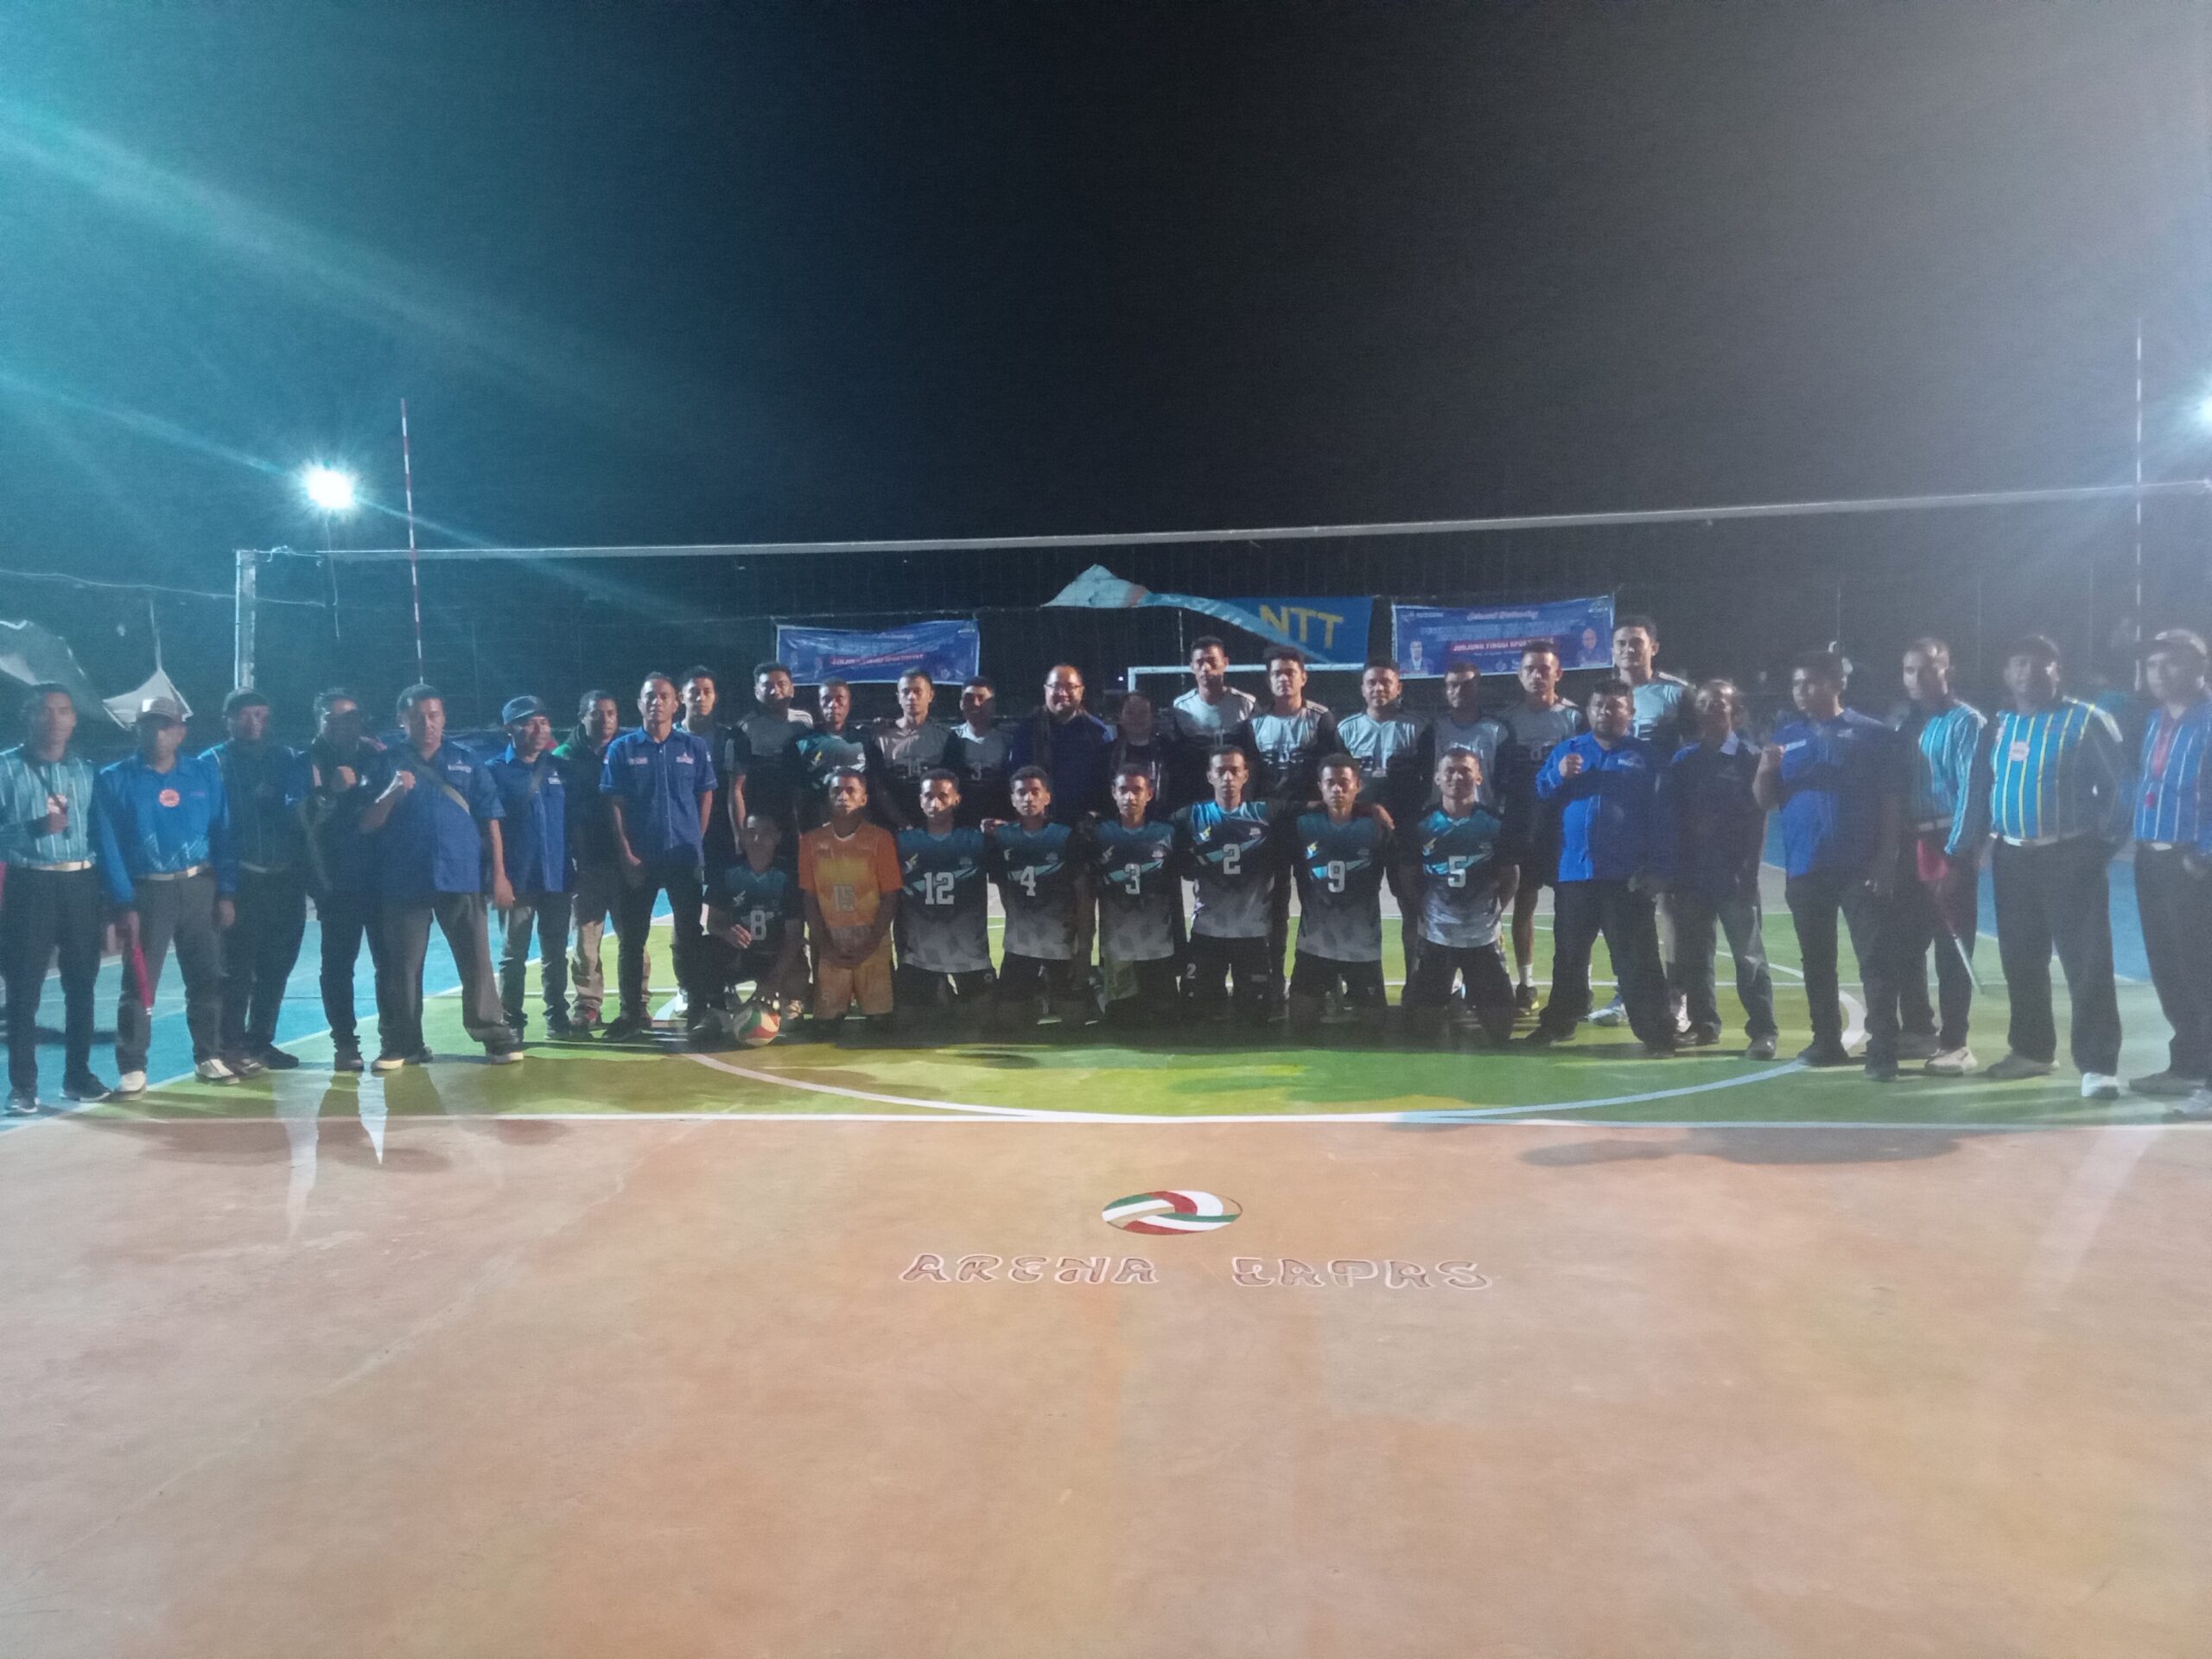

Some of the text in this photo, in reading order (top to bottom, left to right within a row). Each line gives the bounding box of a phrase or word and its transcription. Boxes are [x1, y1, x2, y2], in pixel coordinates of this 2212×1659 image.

[1259, 604, 1344, 650] NTT
[1223, 843, 1241, 875] 2
[1447, 855, 1467, 888] 5
[923, 871, 956, 906] 12
[1020, 865, 1037, 897] 4
[1124, 862, 1141, 895] 3
[1327, 860, 1346, 893] 9
[749, 909, 767, 941] 8
[899, 1253, 1160, 1285] ARENA
